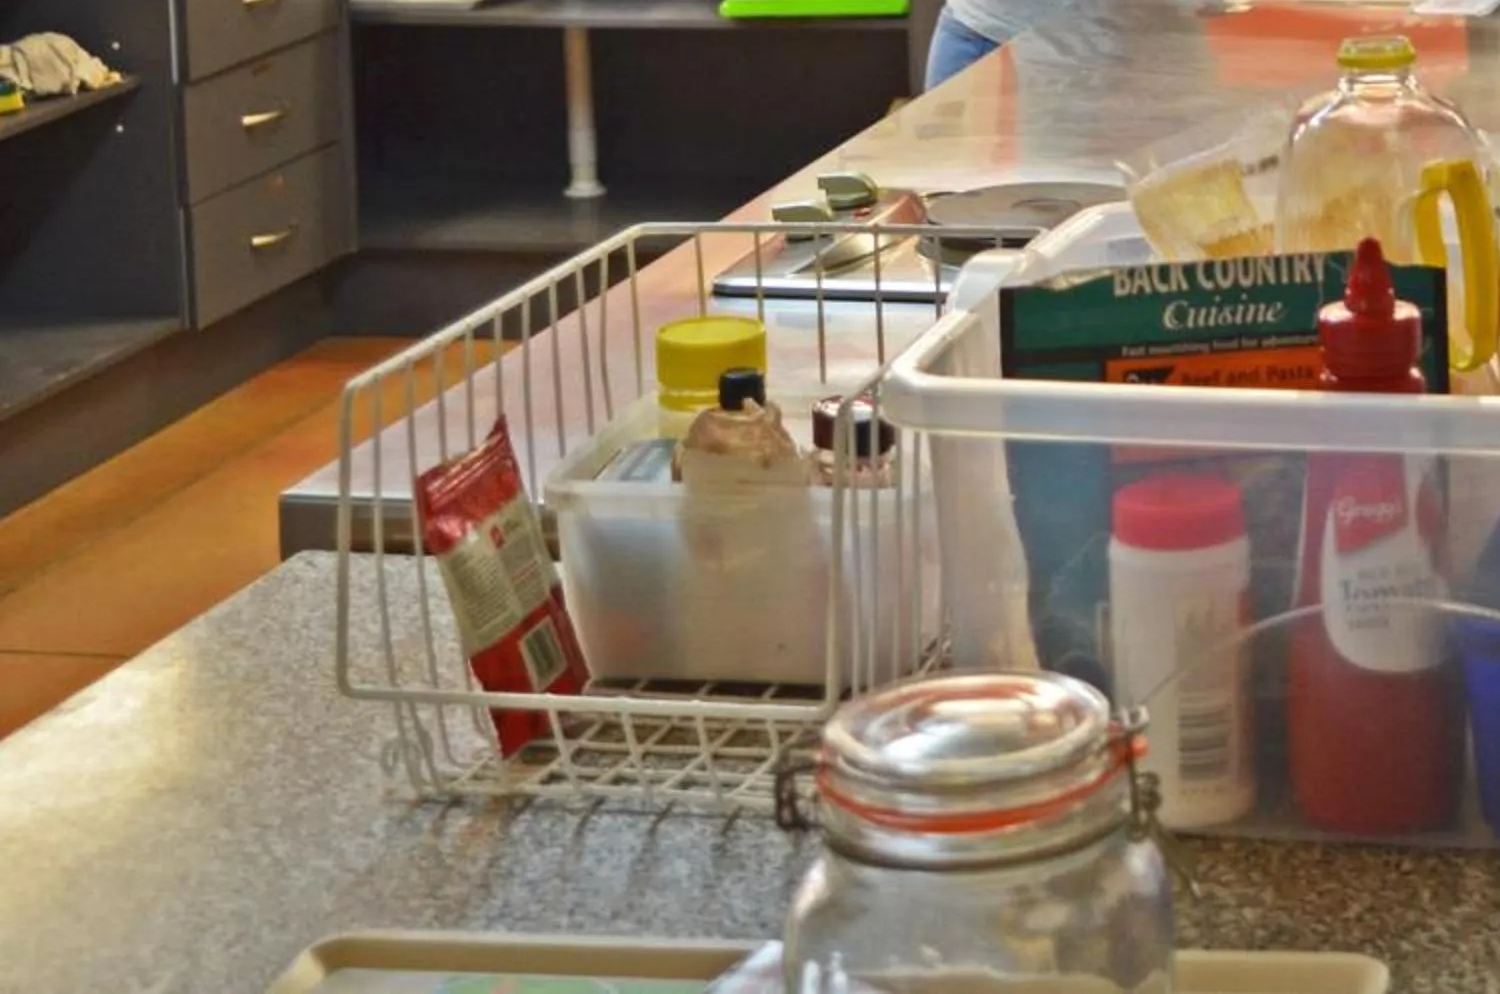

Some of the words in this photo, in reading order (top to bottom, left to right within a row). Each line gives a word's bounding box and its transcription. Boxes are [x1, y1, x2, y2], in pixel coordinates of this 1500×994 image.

[1114, 263, 1188, 296] BACK
[1197, 254, 1325, 289] COUNTRY
[1163, 294, 1285, 330] Cuisine
